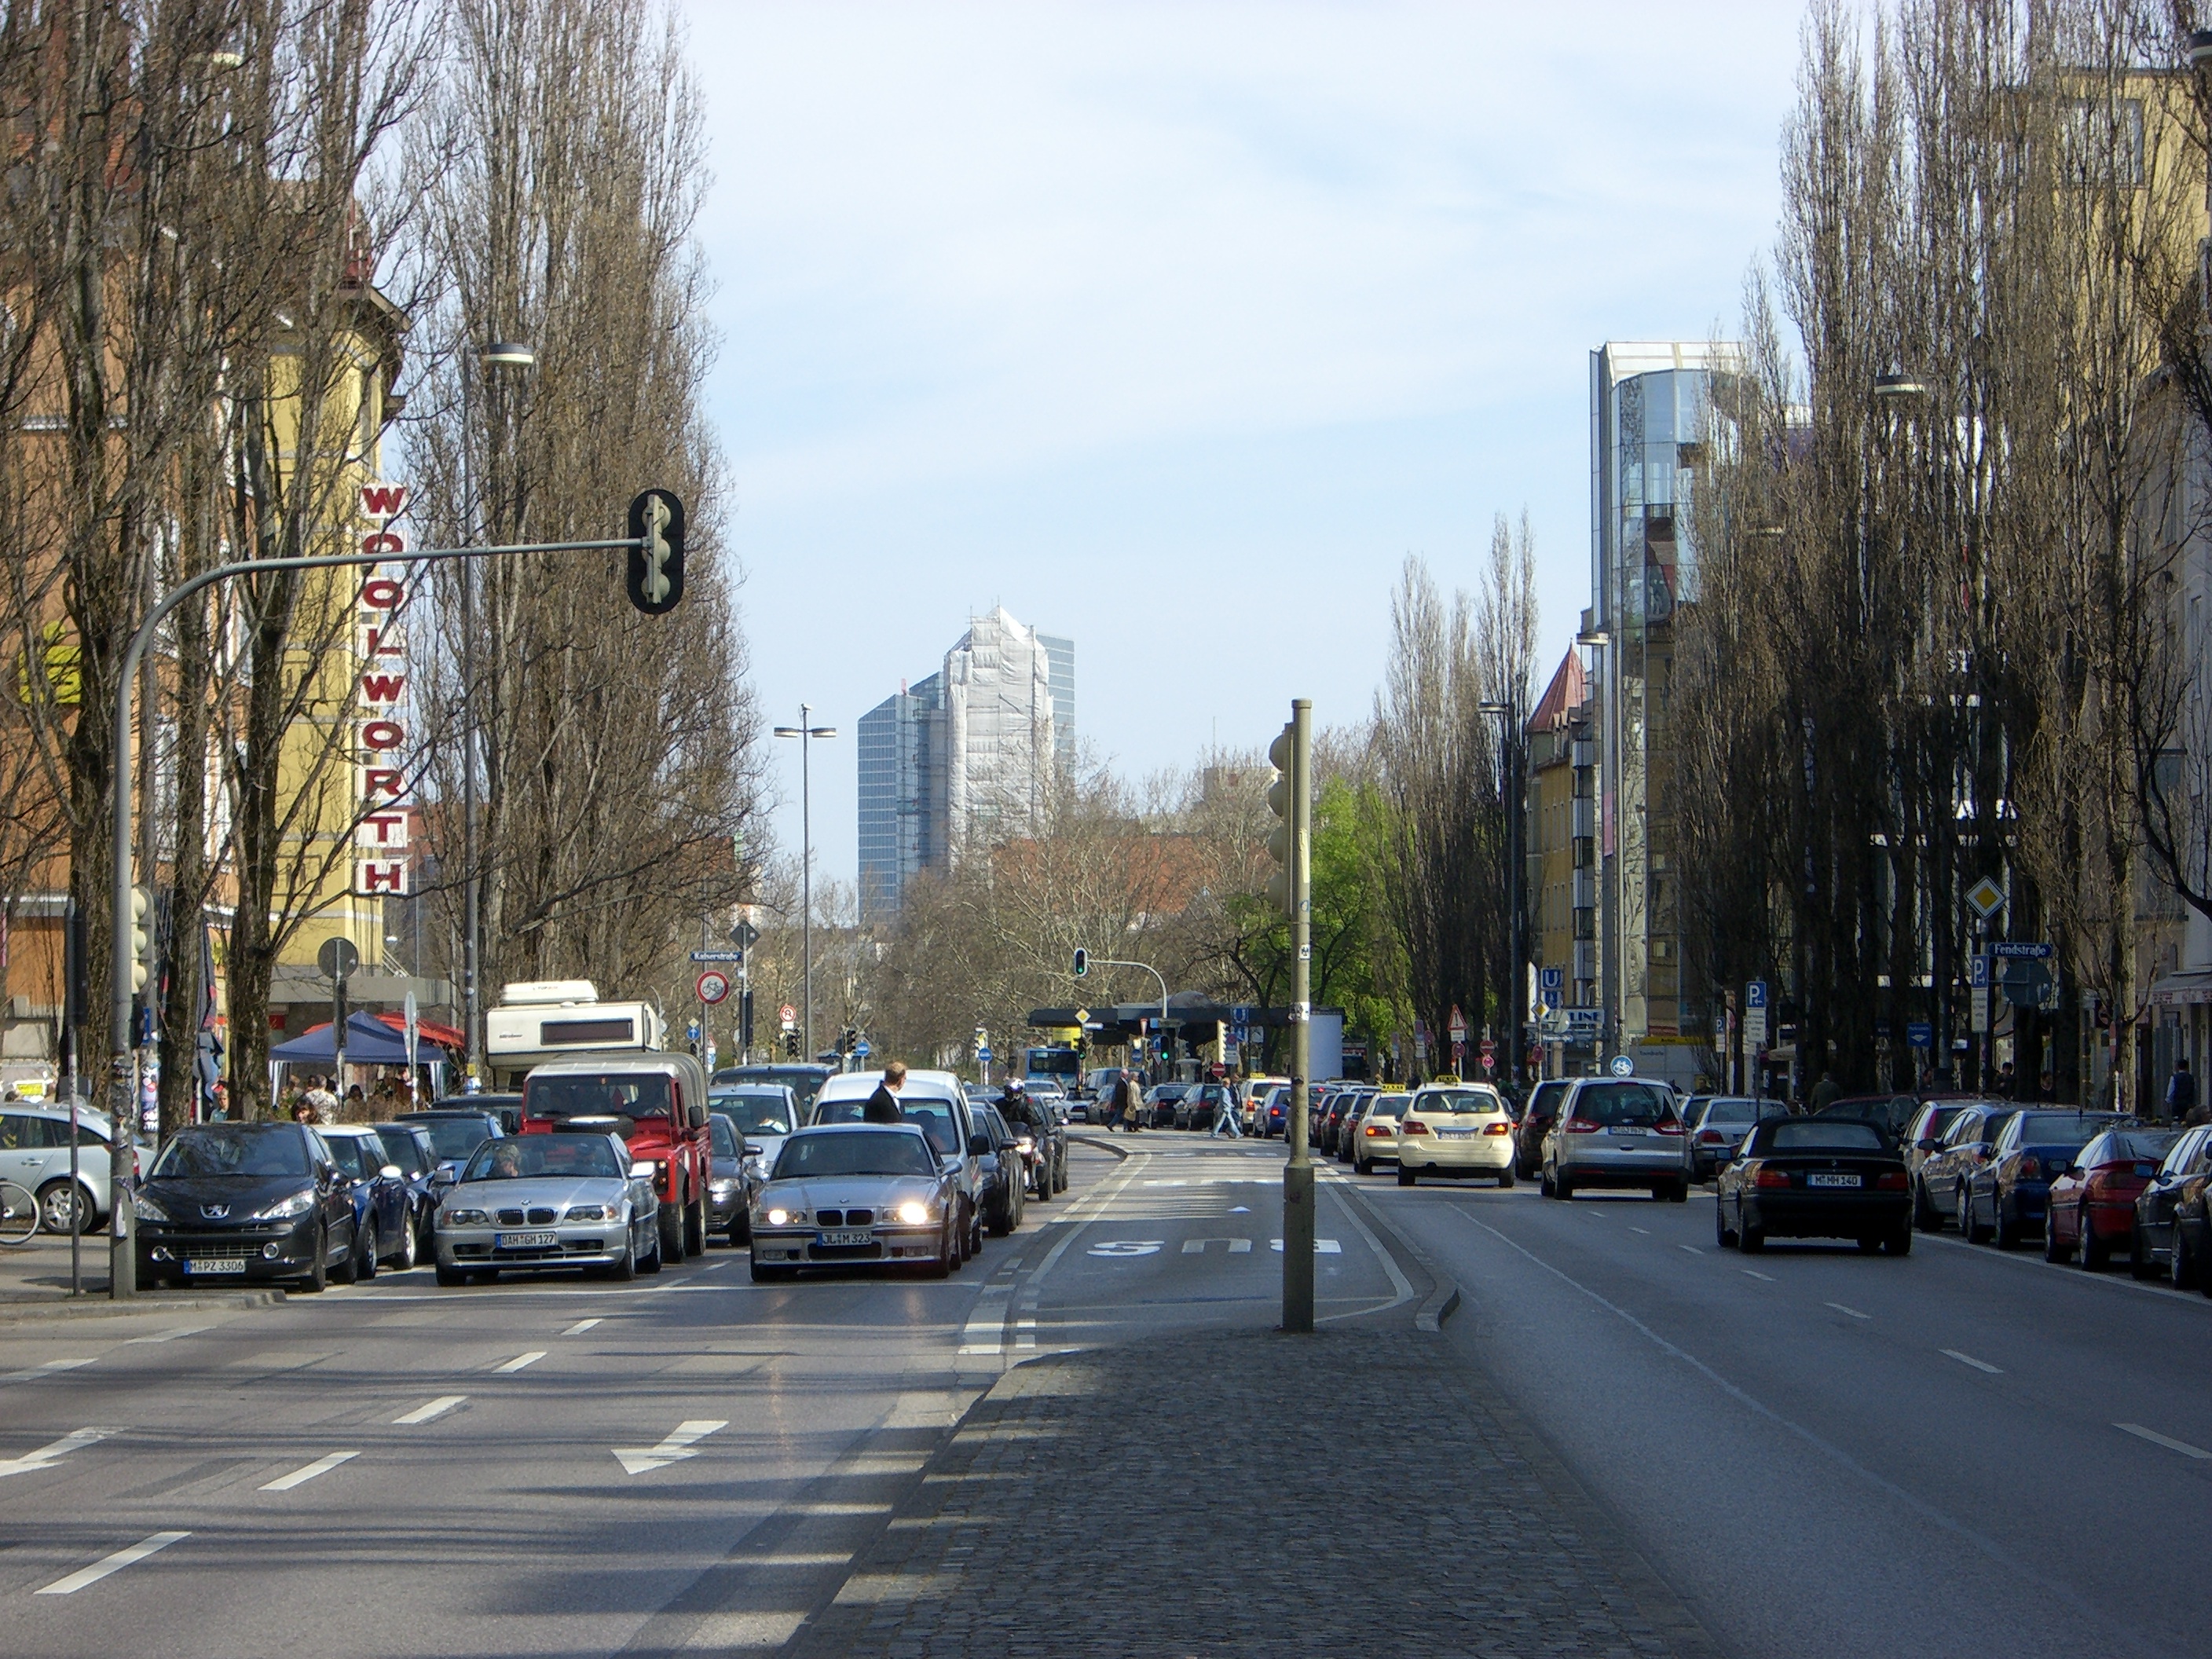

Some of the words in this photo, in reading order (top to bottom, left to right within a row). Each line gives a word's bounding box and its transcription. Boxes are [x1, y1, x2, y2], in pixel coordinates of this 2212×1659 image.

[361, 487, 405, 891] WOOLWORTH
[694, 952, 738, 961] Kaiserstraße
[1994, 944, 2046, 957] Fendstraße
[1973, 959, 1983, 985] P
[1545, 971, 1558, 987] U
[1749, 984, 1760, 1005] P
[502, 1235, 518, 1246] DAH
[537, 1234, 555, 1244] 127
[842, 1234, 850, 1243] M
[851, 1233, 870, 1243] 323
[190, 1261, 197, 1272] M
[203, 1261, 217, 1272] PZ
[218, 1260, 244, 1272] 3306
